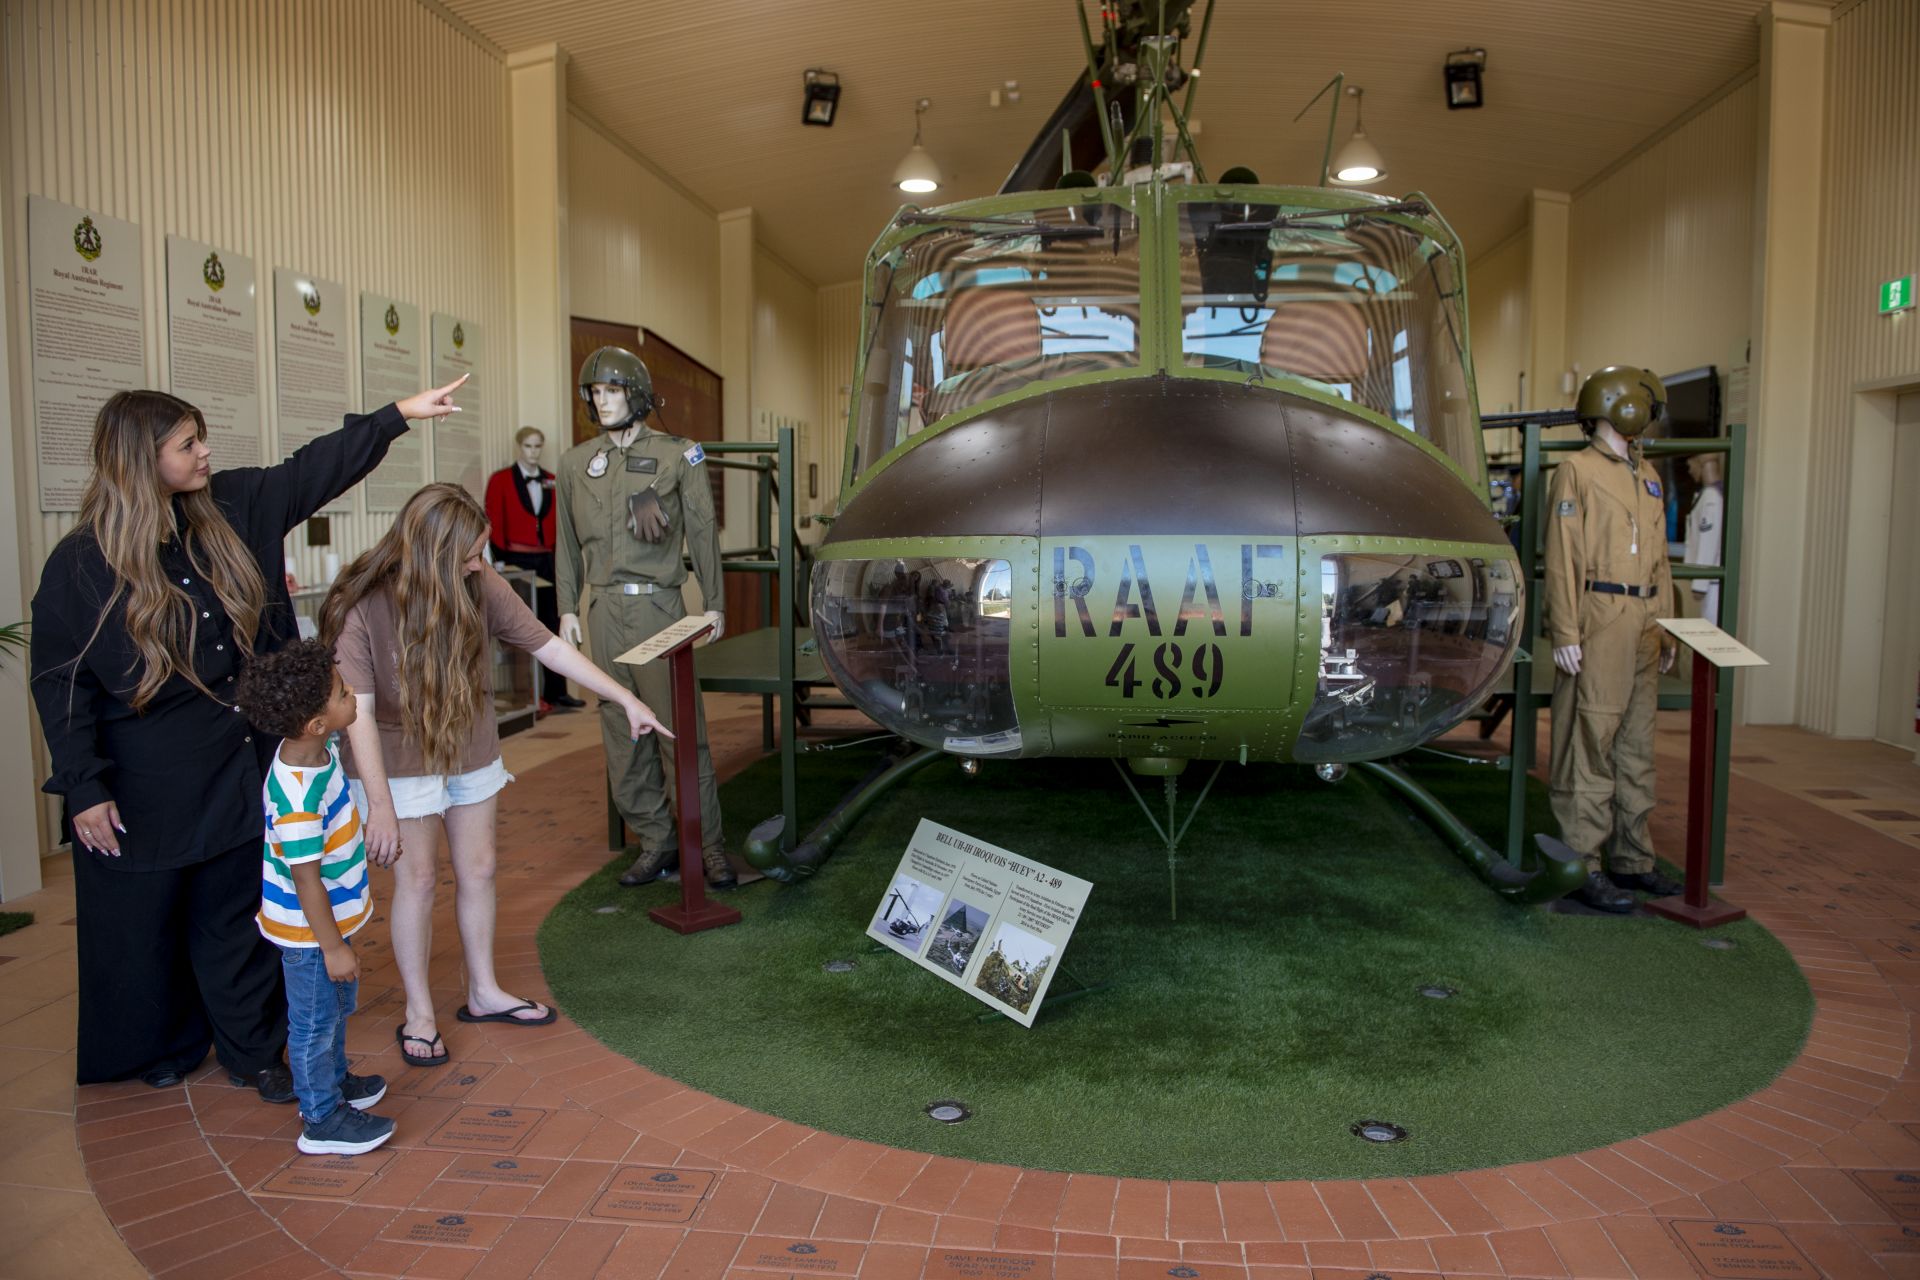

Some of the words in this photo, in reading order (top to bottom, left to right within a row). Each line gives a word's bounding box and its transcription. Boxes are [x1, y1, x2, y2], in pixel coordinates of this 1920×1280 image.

[53, 268, 70, 280] Royal
[71, 273, 99, 286] Australian
[99, 278, 124, 291] Regiment
[1053, 544, 1283, 638] RAAF
[1105, 642, 1224, 699] 489
[935, 831, 953, 846] BELL
[972, 845, 1008, 868] IROQUOIS
[1033, 871, 1046, 883] A2
[1048, 876, 1063, 890] 489
[759, 1254, 791, 1262] TREVOR
[944, 1254, 971, 1262] DAVE
